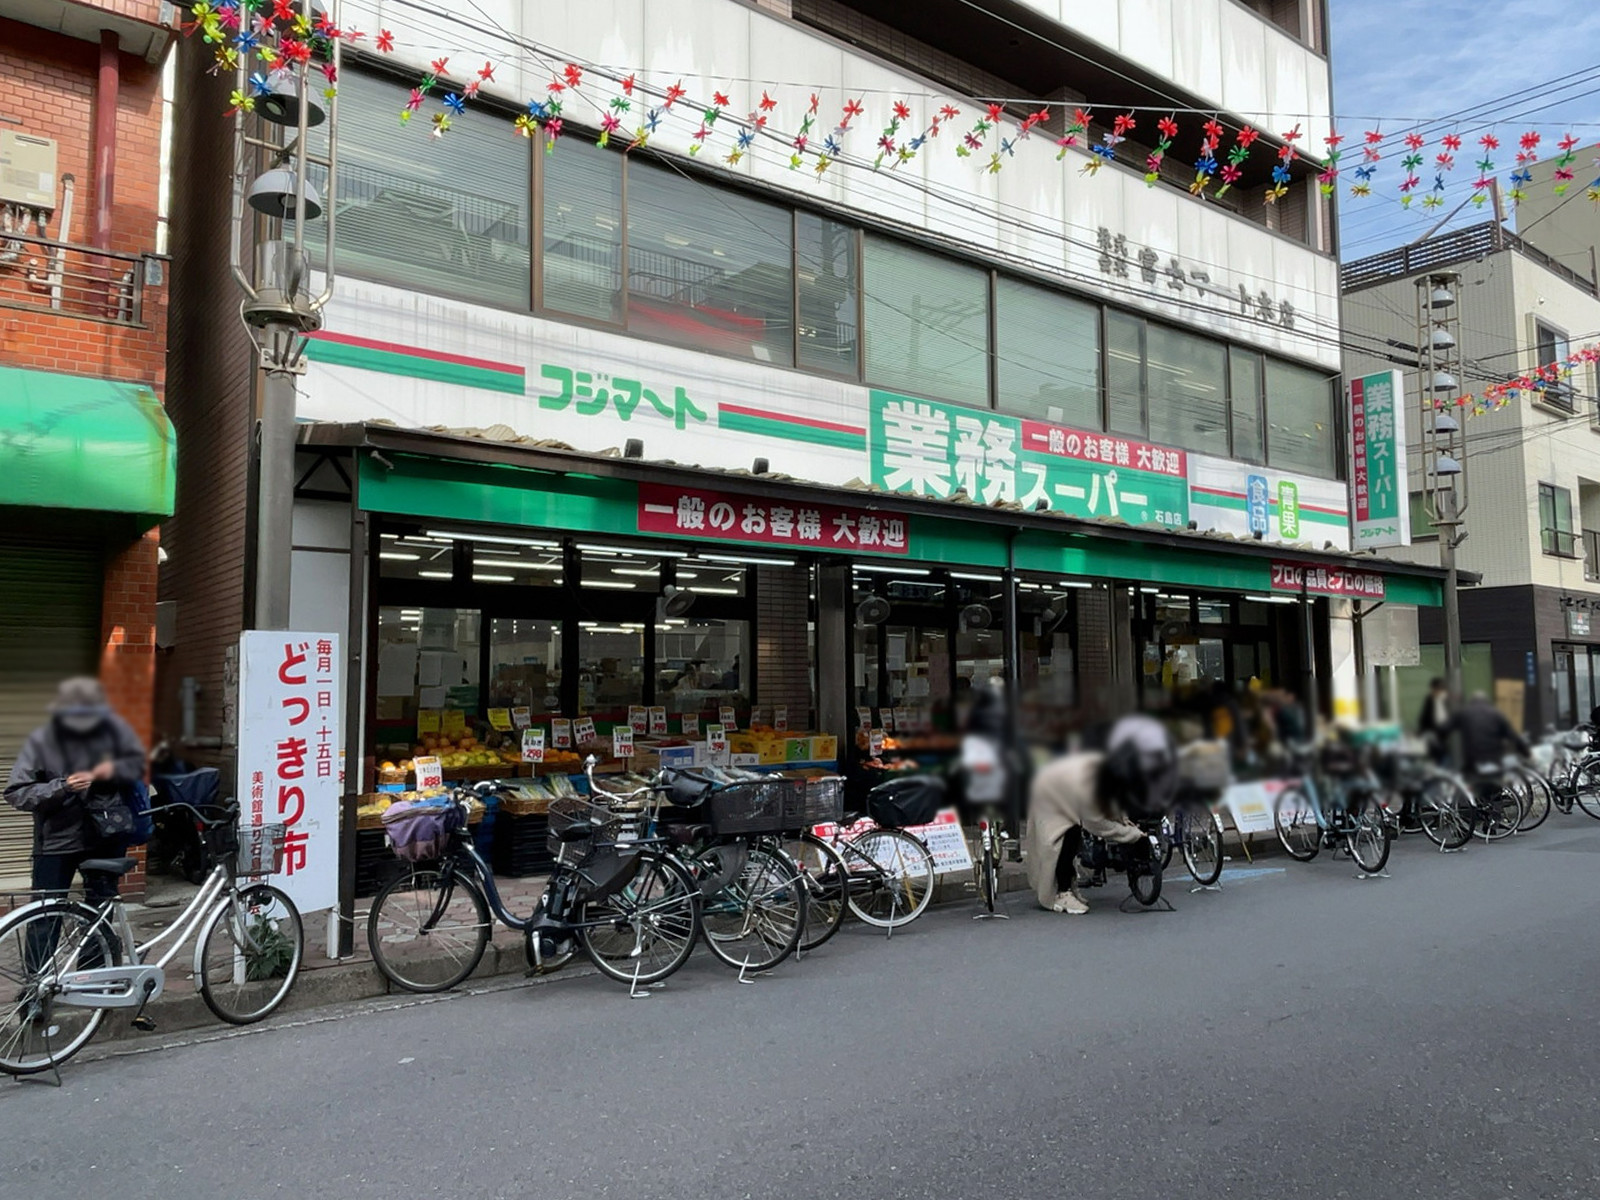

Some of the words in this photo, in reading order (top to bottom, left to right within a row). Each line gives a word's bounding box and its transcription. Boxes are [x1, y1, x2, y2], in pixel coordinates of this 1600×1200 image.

[882, 400, 1148, 517] 業務スーパー
[1031, 428, 1130, 466] 一般のお客様
[1137, 446, 1181, 476] 大歓迎
[1366, 382, 1393, 510] 業務スーパー
[644, 495, 822, 541] 一般のお客様
[832, 513, 905, 549] 大歓迎
[1250, 478, 1267, 531] 食品
[1280, 485, 1297, 535] 青果
[271, 641, 310, 877] どっきり市
